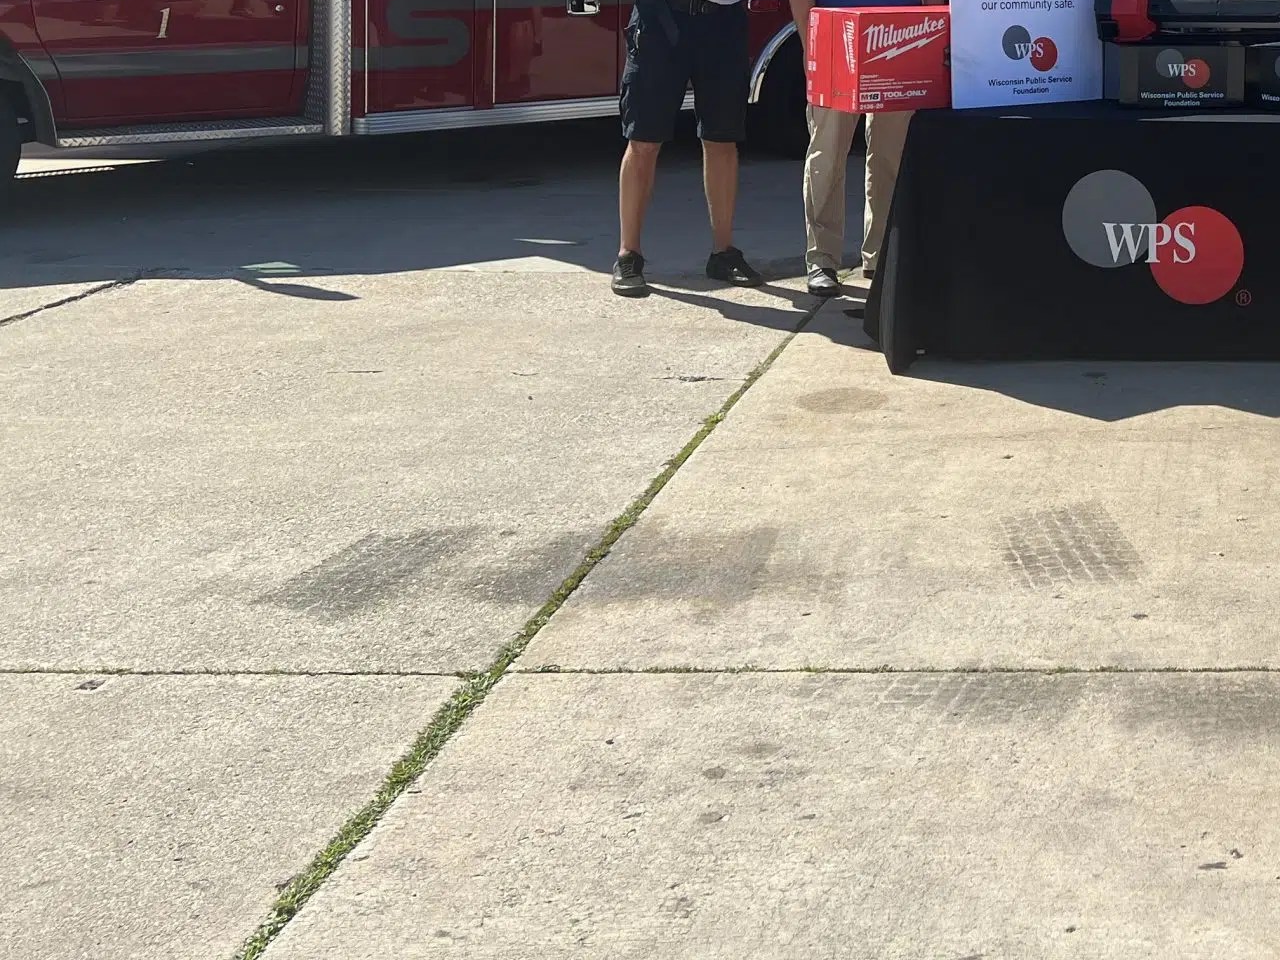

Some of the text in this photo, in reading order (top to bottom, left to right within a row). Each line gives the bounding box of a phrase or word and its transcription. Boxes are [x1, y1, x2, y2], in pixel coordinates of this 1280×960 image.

[981, 0, 997, 10] our
[1000, 0, 1052, 12] community
[156, 7, 171, 39] 1
[862, 17, 945, 54] Milwaukee
[1014, 42, 1044, 58] WPS
[1167, 63, 1196, 77] WPS
[988, 76, 1073, 87] Wisconsin Public Service
[860, 92, 880, 102] M18
[883, 90, 927, 98] TOOL-ONLY
[1012, 87, 1049, 95] Foundation
[1140, 91, 1224, 99] Wisconsin Public Service
[1164, 99, 1200, 107] Foundation
[1102, 222, 1196, 264] WPS
